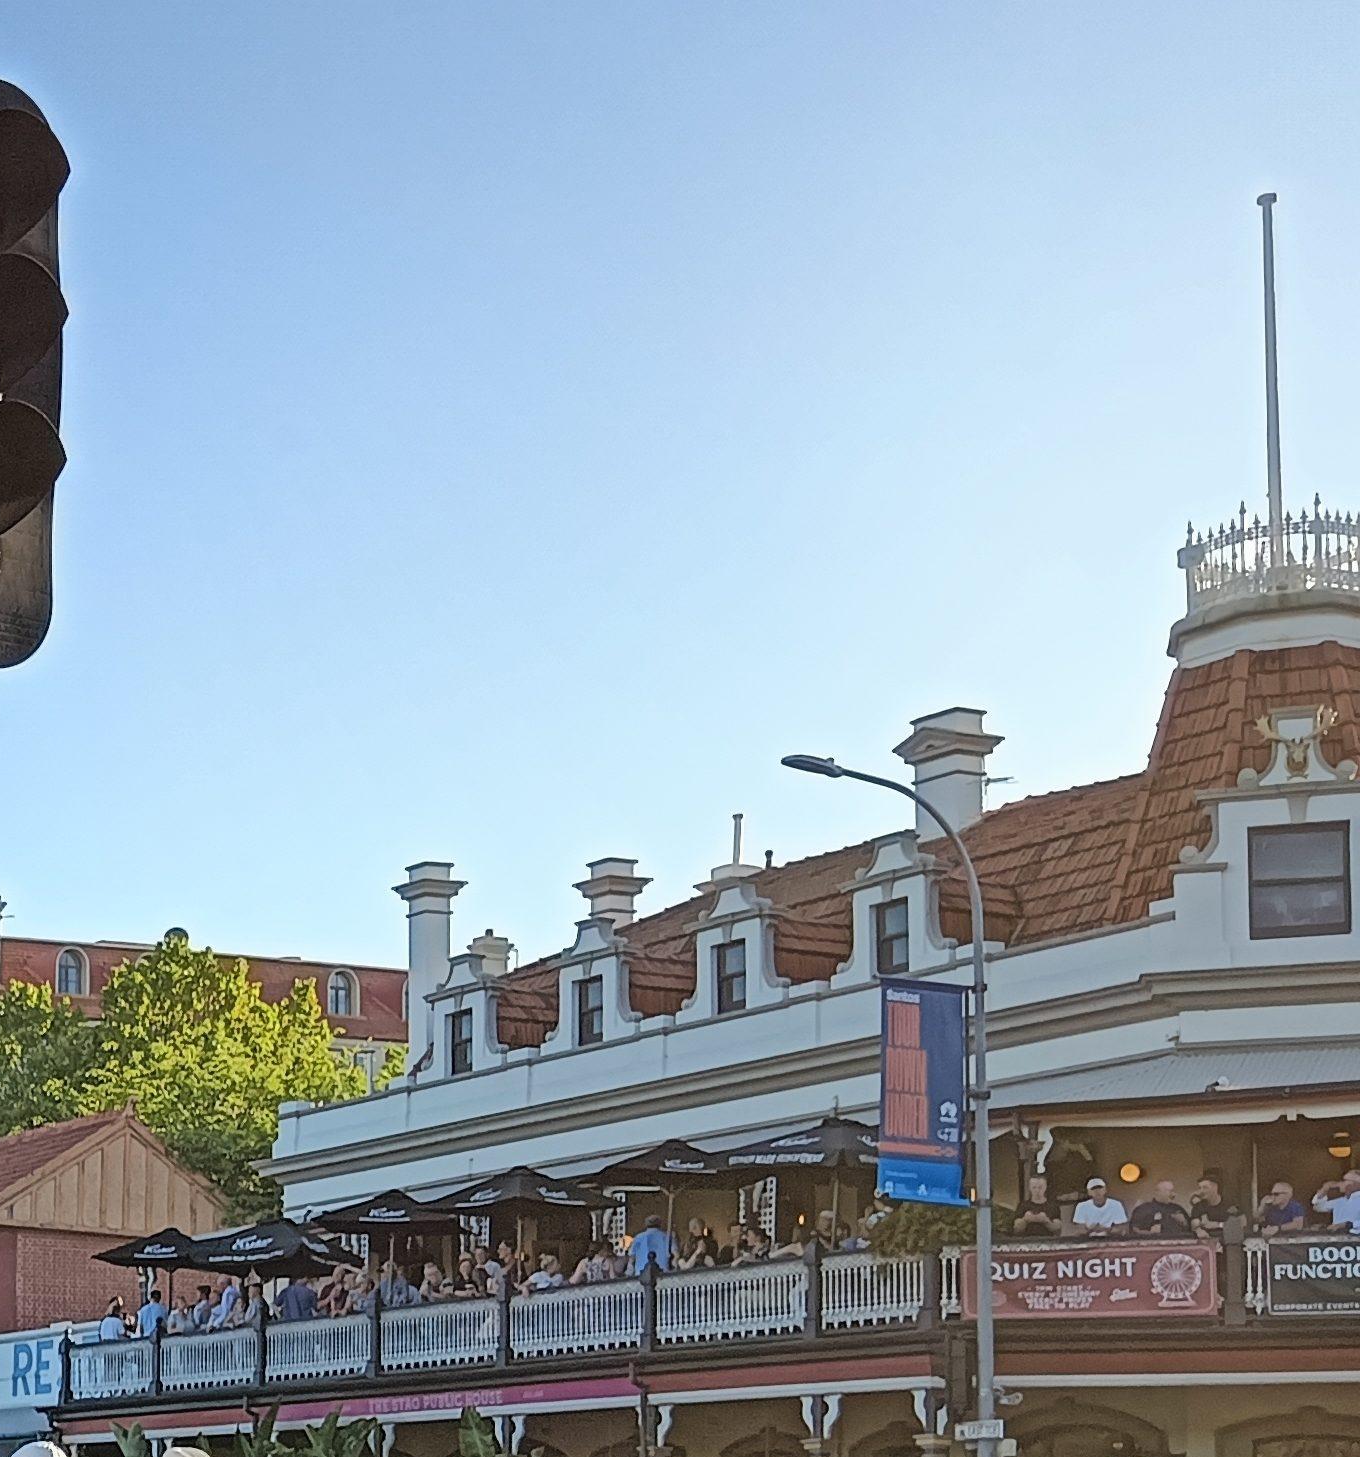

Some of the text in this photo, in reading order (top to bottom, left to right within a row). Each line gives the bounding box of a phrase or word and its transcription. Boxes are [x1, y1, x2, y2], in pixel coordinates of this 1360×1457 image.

[991, 1257, 1137, 1281] QUIZ NIGHT
[1273, 1303, 1323, 1311] CORPORATE
[368, 1400, 389, 1414] THE
[423, 1394, 463, 1409] PUBLIC
[465, 1390, 504, 1407] HOUSE
